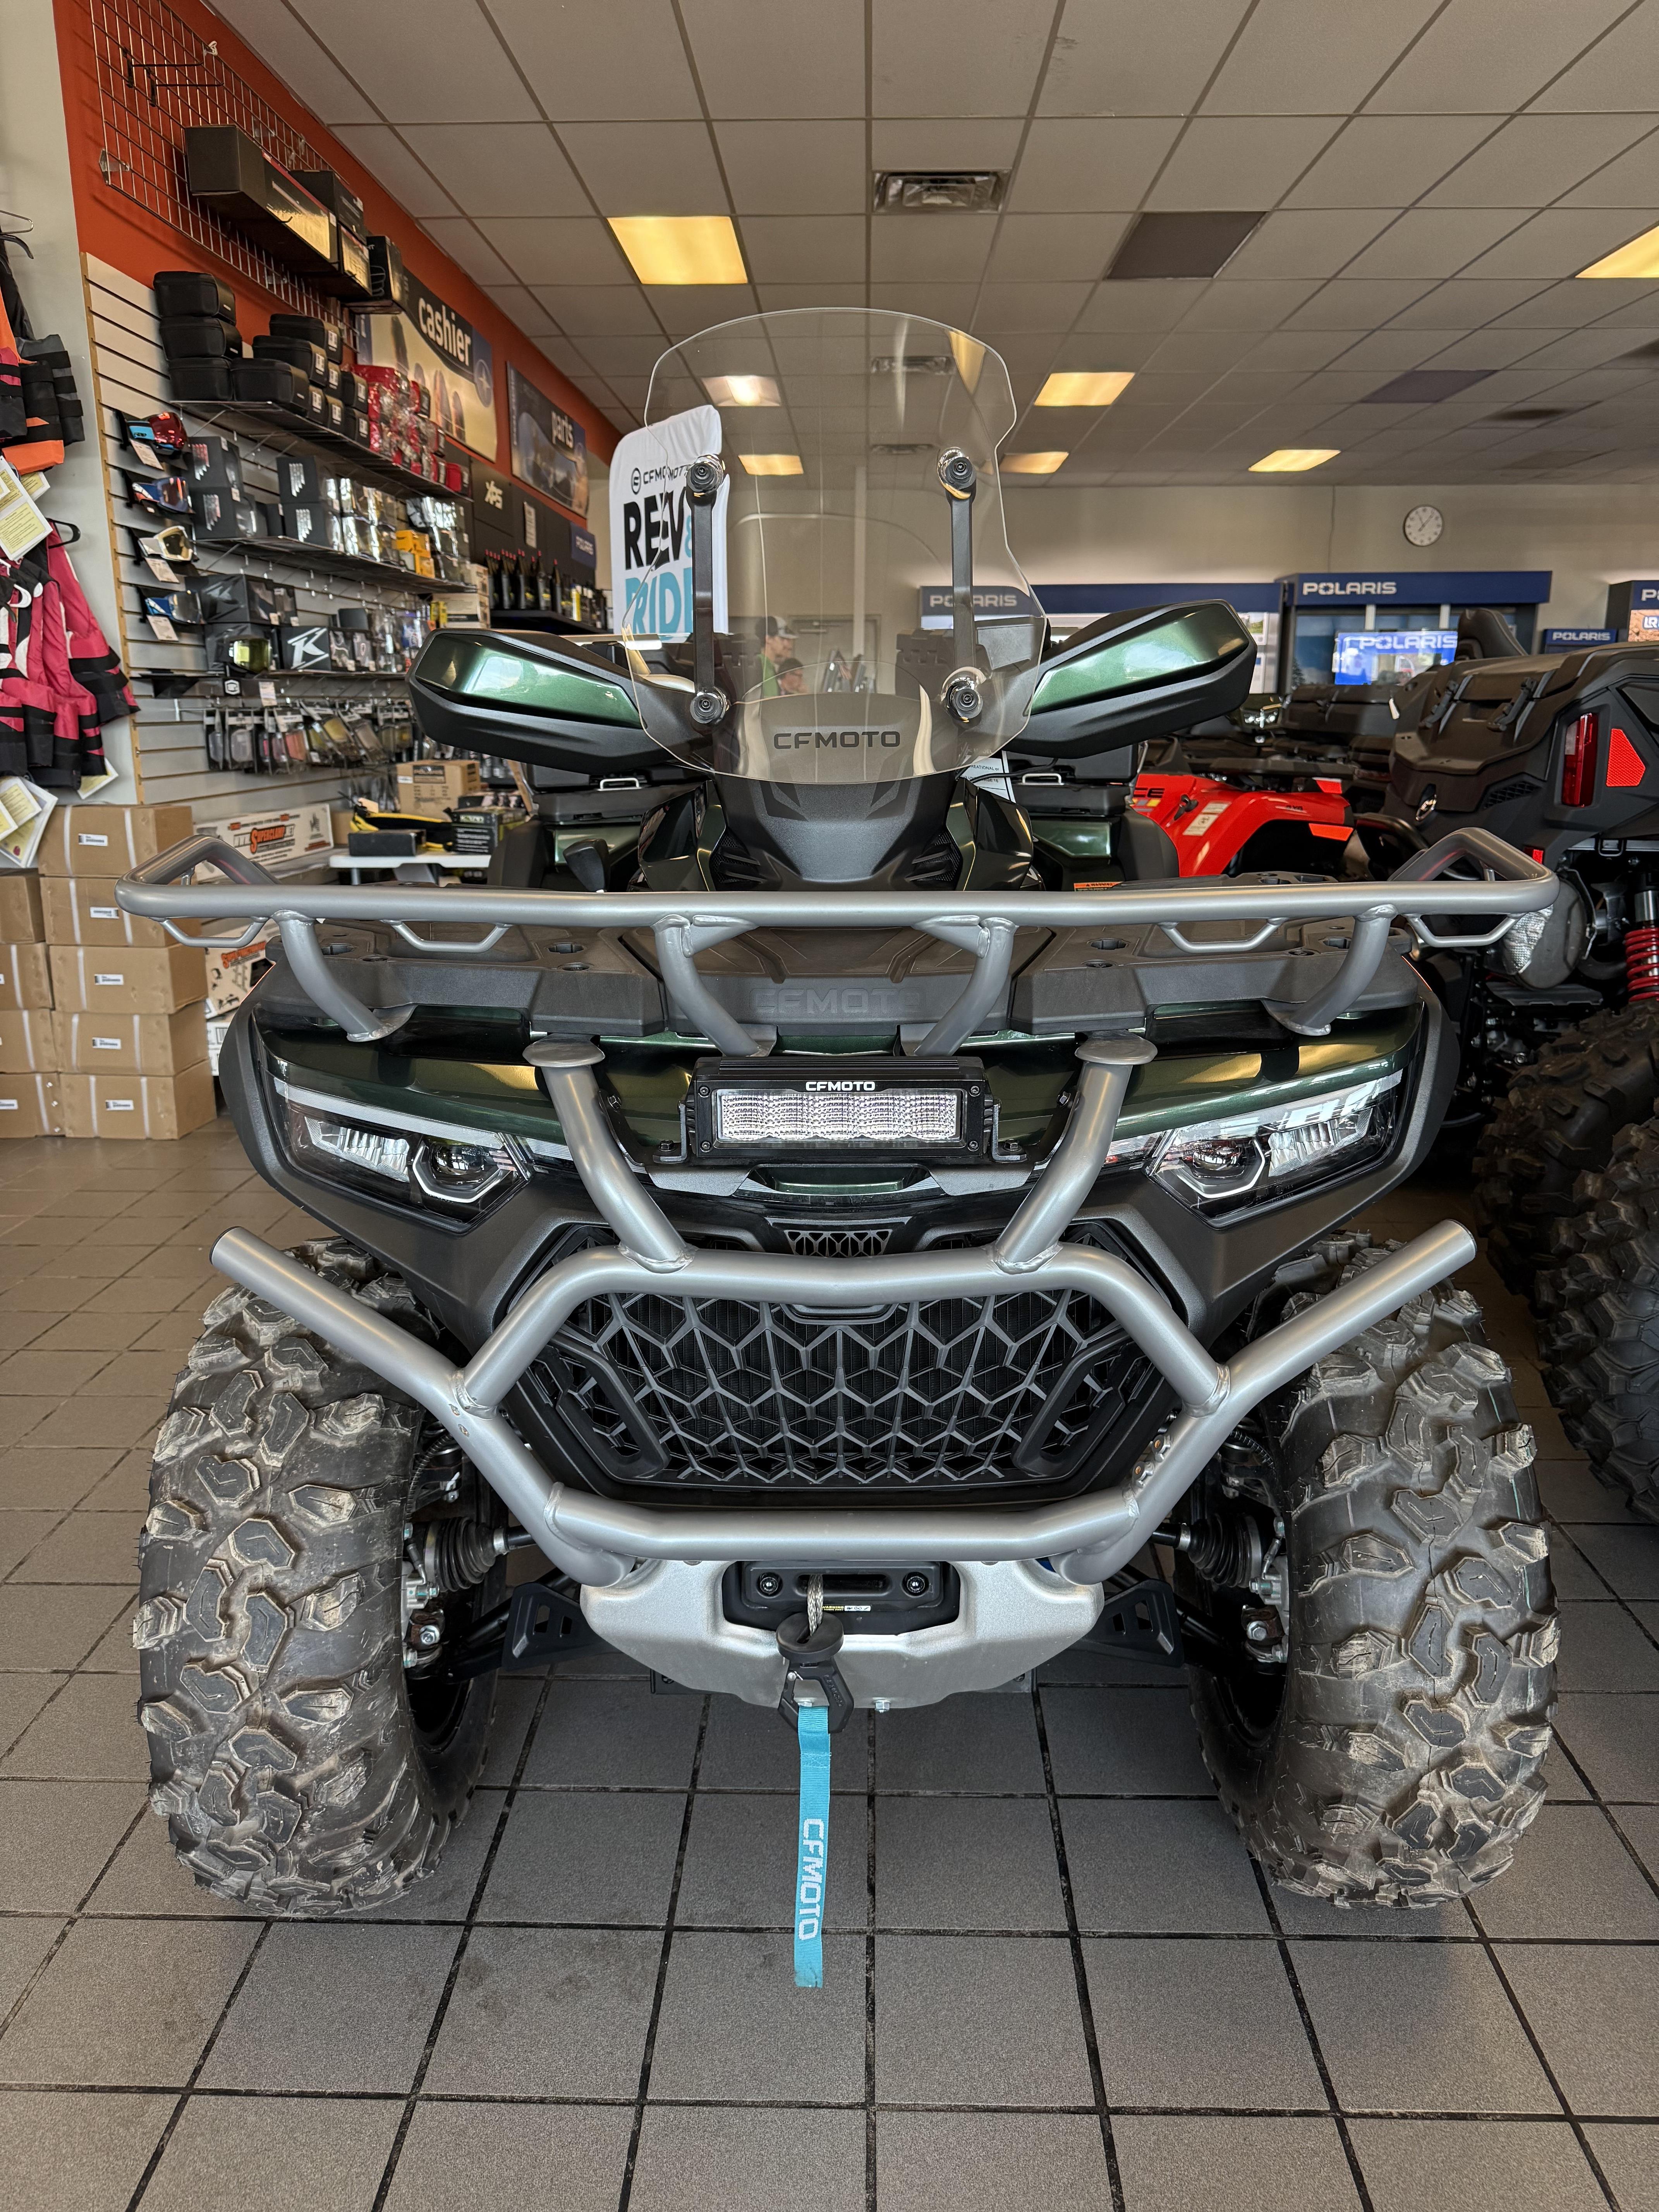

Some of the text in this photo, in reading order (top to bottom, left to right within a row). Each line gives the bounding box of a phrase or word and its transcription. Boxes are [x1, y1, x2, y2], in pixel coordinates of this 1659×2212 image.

[1303, 582, 1397, 595] POLARIS
[1642, 589, 1659, 601] P
[625, 567, 693, 641] RID
[930, 595, 1017, 607] POARIS
[1359, 635, 1458, 649] POLARIS
[1553, 632, 1611, 641] POLARIS
[774, 731, 900, 749] CFMOTO
[750, 988, 925, 1013] CFMOTO
[805, 1081, 875, 1091] CFMOTO
[799, 1819, 824, 1940] CFMOTO
